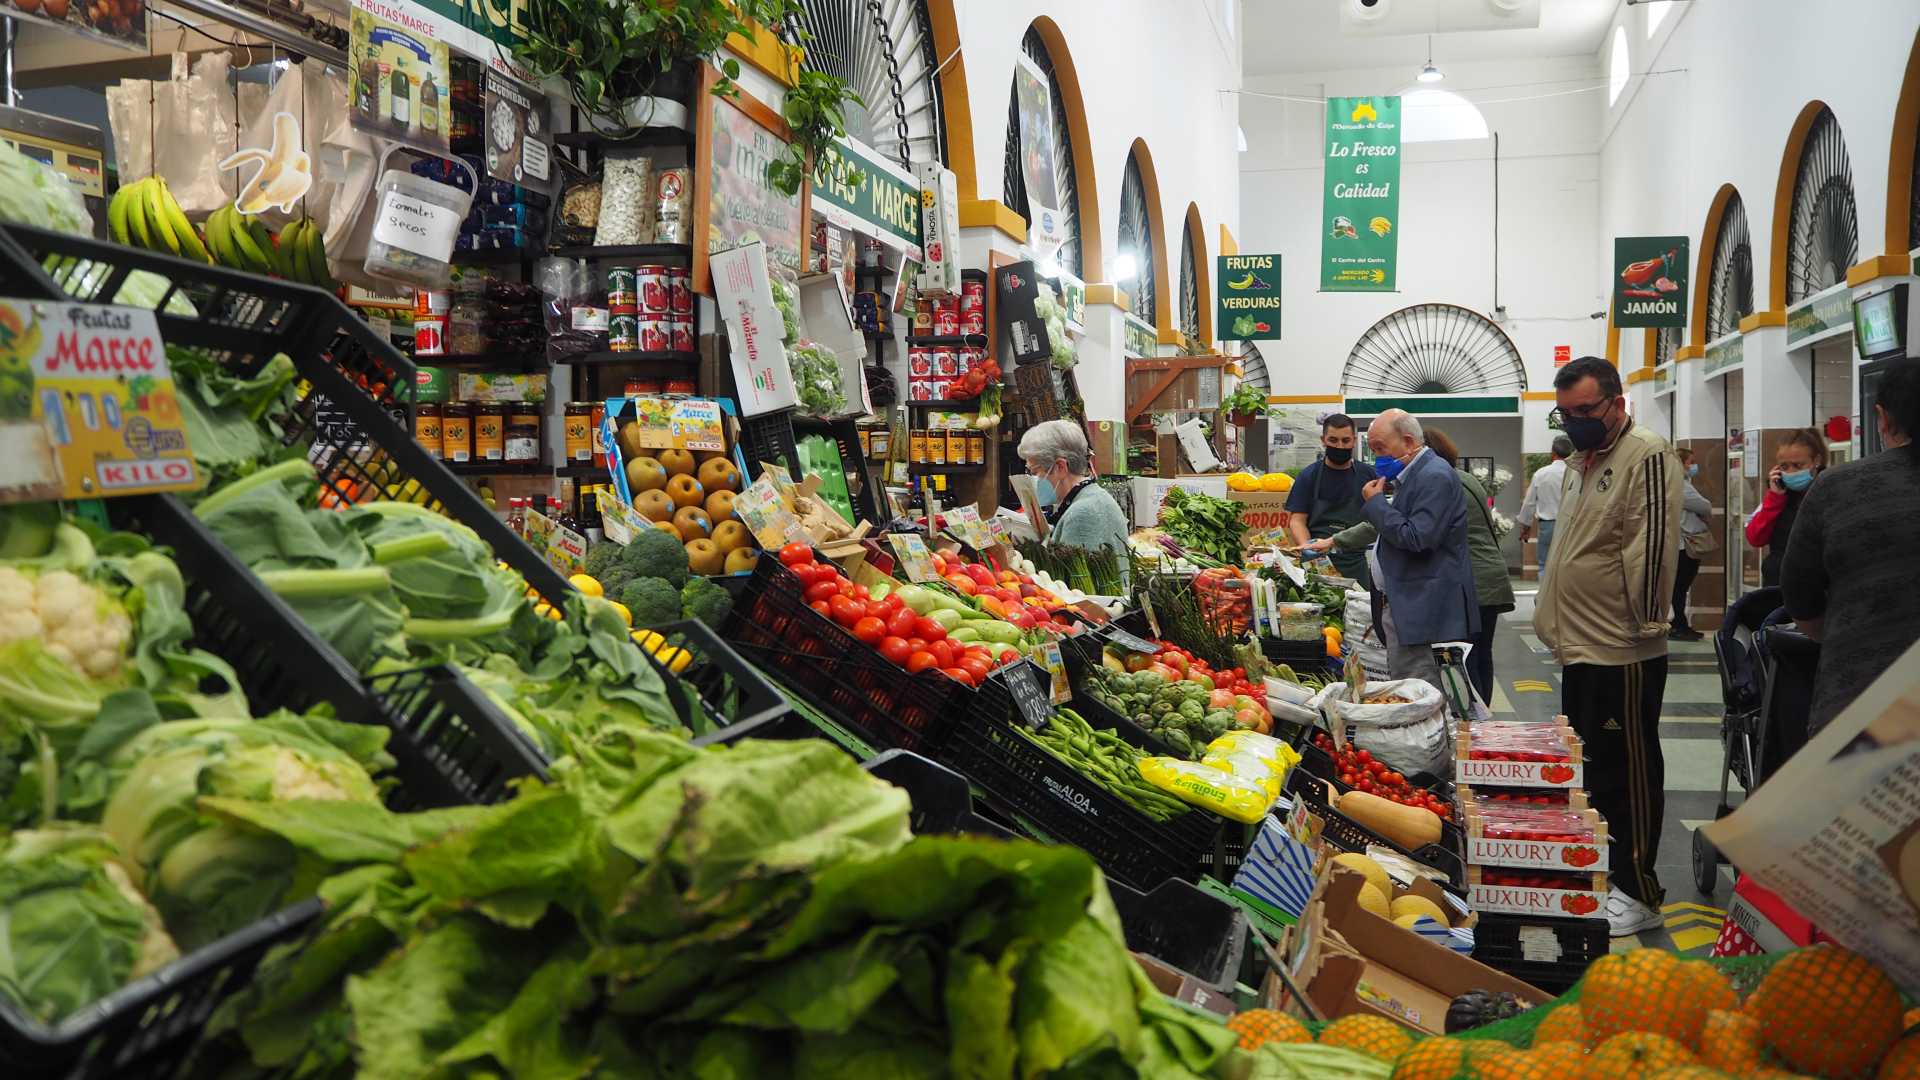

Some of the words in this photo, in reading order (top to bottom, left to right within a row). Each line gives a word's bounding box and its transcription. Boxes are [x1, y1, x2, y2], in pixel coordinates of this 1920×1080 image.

[401, 14, 434, 37] MARCE
[1330, 142, 1349, 157] Lo
[1352, 142, 1396, 157] Fresco
[1355, 163, 1369, 174] es
[1334, 183, 1390, 198] Calidad
[872, 173, 918, 236] MARCE
[928, 210, 936, 242] VENOSTA
[1227, 256, 1273, 270] FRUTAS
[1222, 297, 1280, 309] VERDURAS
[1623, 299, 1677, 314] JAMÓN
[68, 307, 131, 330] Frutas
[46, 331, 155, 372] Marce
[688, 442, 721, 450] KILO
[104, 463, 188, 483] KILO
[1463, 763, 1535, 778] LUXURY
[1060, 785, 1090, 811] ALOA
[1175, 778, 1226, 803] Endibias
[1476, 842, 1555, 860] LUXURY
[1476, 888, 1555, 907] LUXURY
